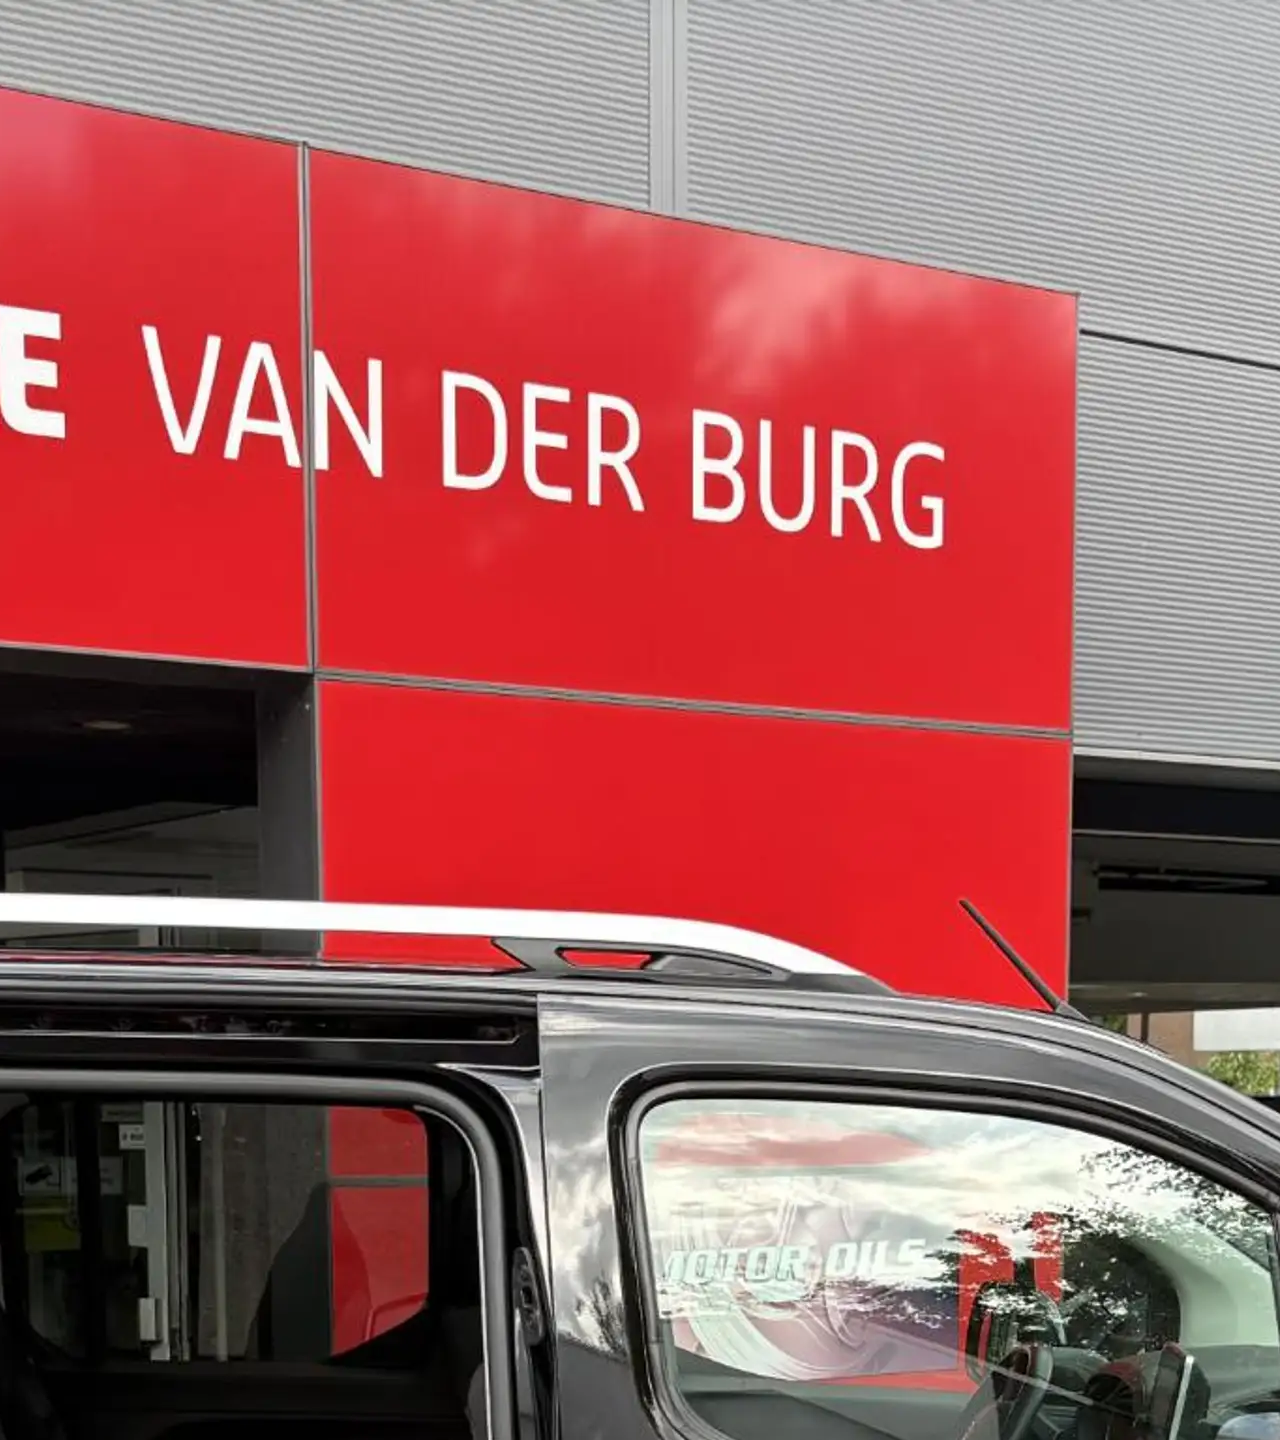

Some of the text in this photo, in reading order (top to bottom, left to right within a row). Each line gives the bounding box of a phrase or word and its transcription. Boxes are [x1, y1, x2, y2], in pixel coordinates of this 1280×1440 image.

[141, 325, 384, 478] VAN
[440, 370, 645, 513] DER
[690, 408, 946, 550] BURG
